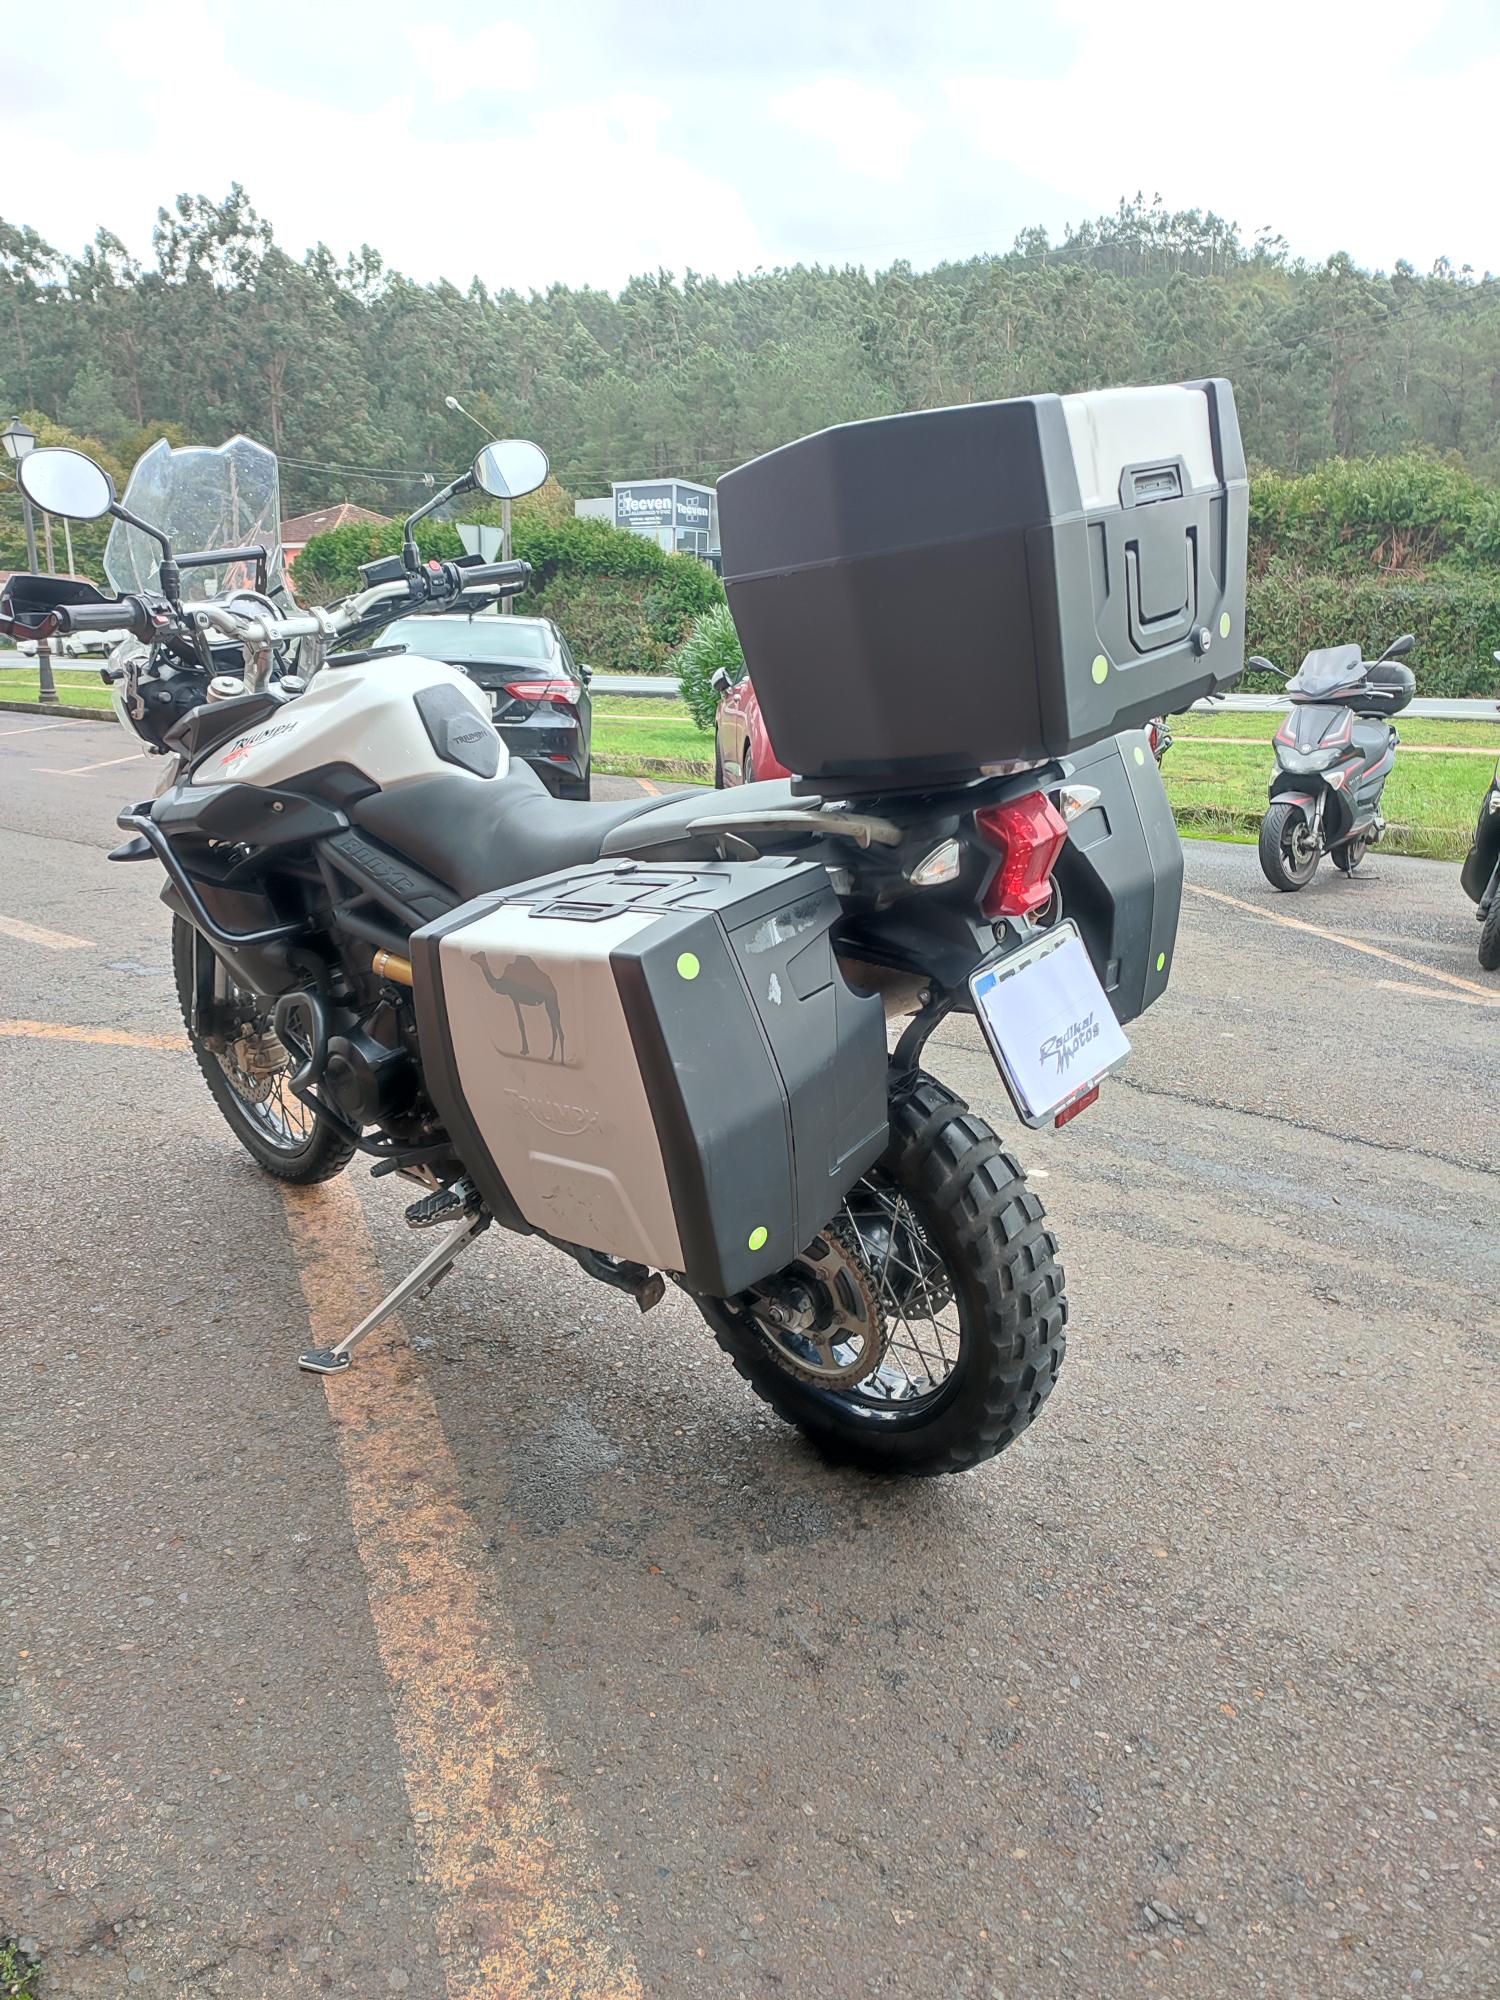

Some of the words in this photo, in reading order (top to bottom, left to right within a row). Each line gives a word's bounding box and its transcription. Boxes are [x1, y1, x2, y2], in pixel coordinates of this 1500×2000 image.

[623, 497, 672, 511] Tecven
[676, 502, 709, 516] Tecven
[230, 721, 299, 754] TRIUMPH
[452, 730, 488, 745] TRIUMPH
